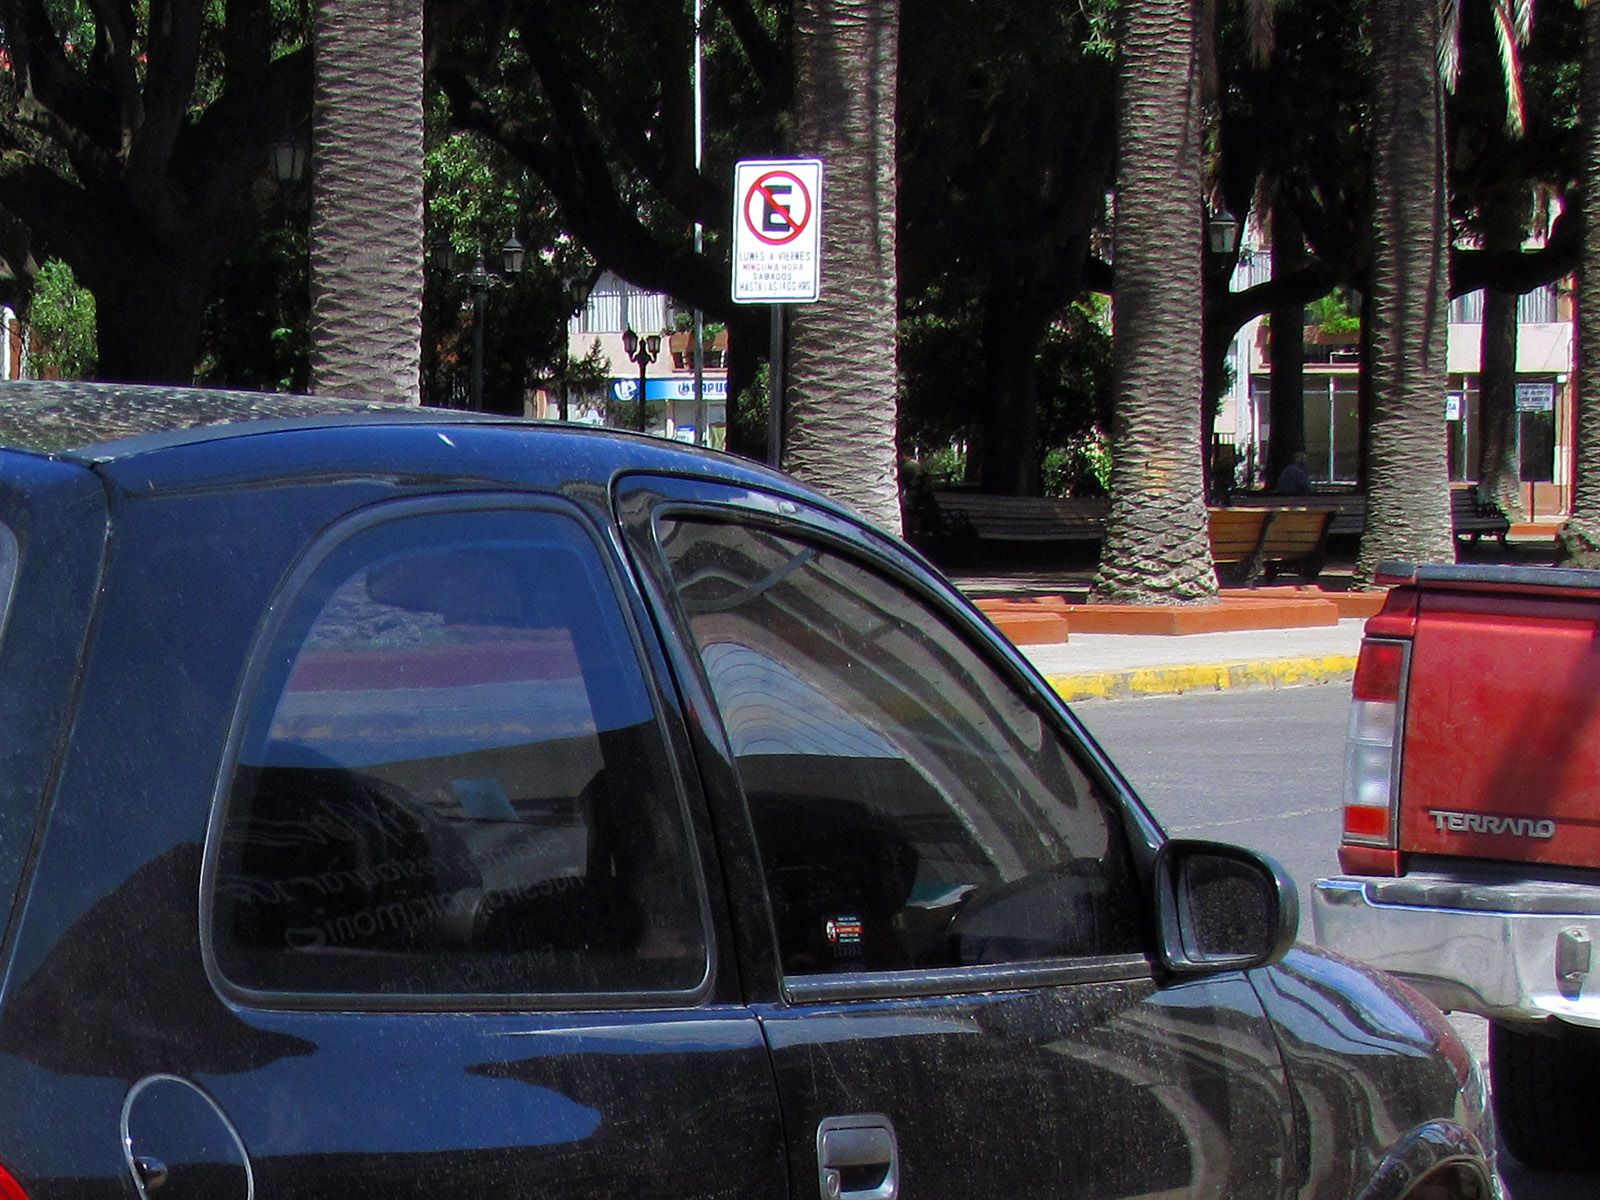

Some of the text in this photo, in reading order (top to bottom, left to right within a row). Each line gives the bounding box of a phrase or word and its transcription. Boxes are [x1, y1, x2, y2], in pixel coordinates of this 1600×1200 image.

[739, 251, 765, 262] LUNES
[778, 251, 811, 262] VIERNES
[742, 263, 804, 271] NINGUNA HORA
[1428, 810, 1556, 839] TERRANO
